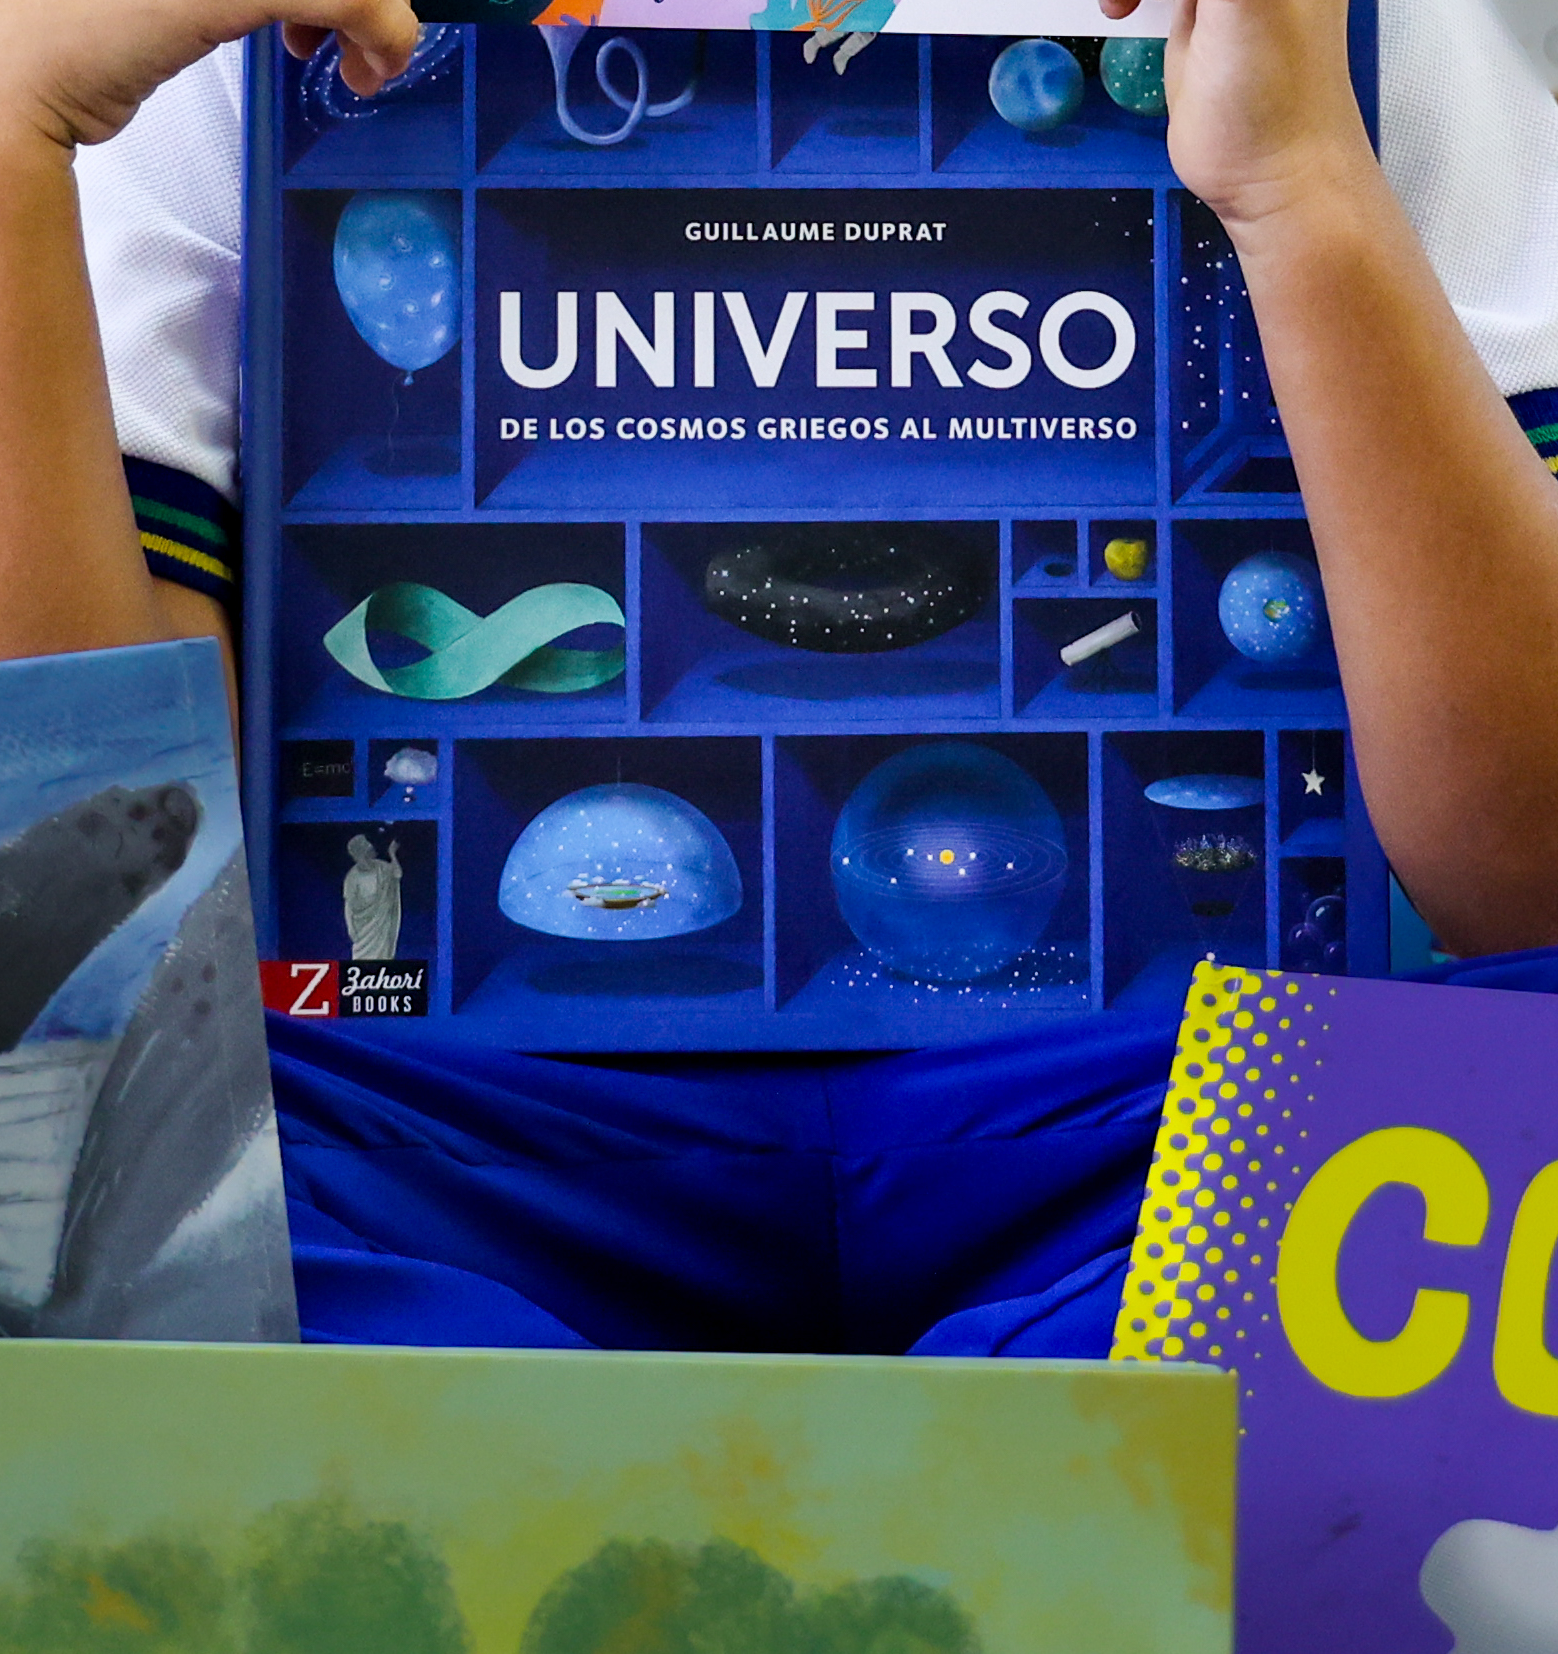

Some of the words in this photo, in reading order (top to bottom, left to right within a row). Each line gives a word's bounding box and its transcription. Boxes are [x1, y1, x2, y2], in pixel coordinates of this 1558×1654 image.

[685, 222, 836, 242] GUILLAUME
[845, 222, 947, 243] DUPRAT
[499, 290, 1137, 389] UNIVERSO
[500, 418, 538, 441] DE
[550, 417, 605, 441] LOS
[616, 417, 747, 441] COSMOS
[757, 417, 890, 441] GRIEGOS
[900, 417, 937, 441] AL
[948, 417, 1137, 441] MULTIVERSO
[289, 963, 330, 1016] Z
[353, 996, 412, 1013] BOOKS
